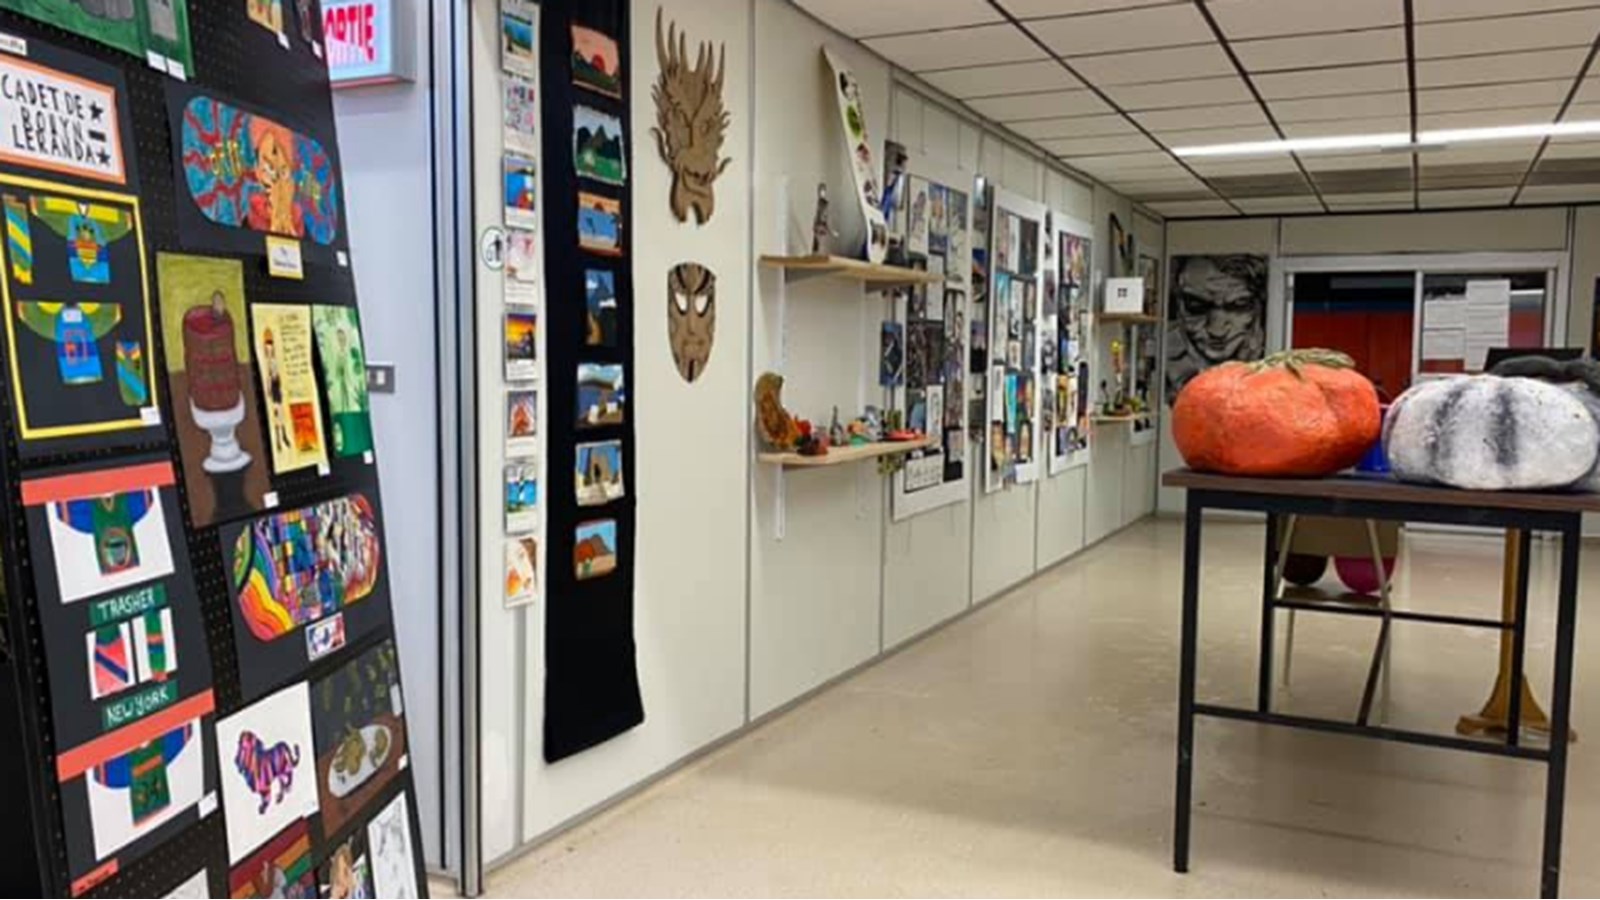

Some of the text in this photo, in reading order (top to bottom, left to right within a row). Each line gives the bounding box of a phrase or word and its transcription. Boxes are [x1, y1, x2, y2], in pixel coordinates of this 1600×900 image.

[323, 4, 374, 61] ORTIE
[1, 73, 85, 121] CADET DE
[97, 588, 156, 621] TRASHER
